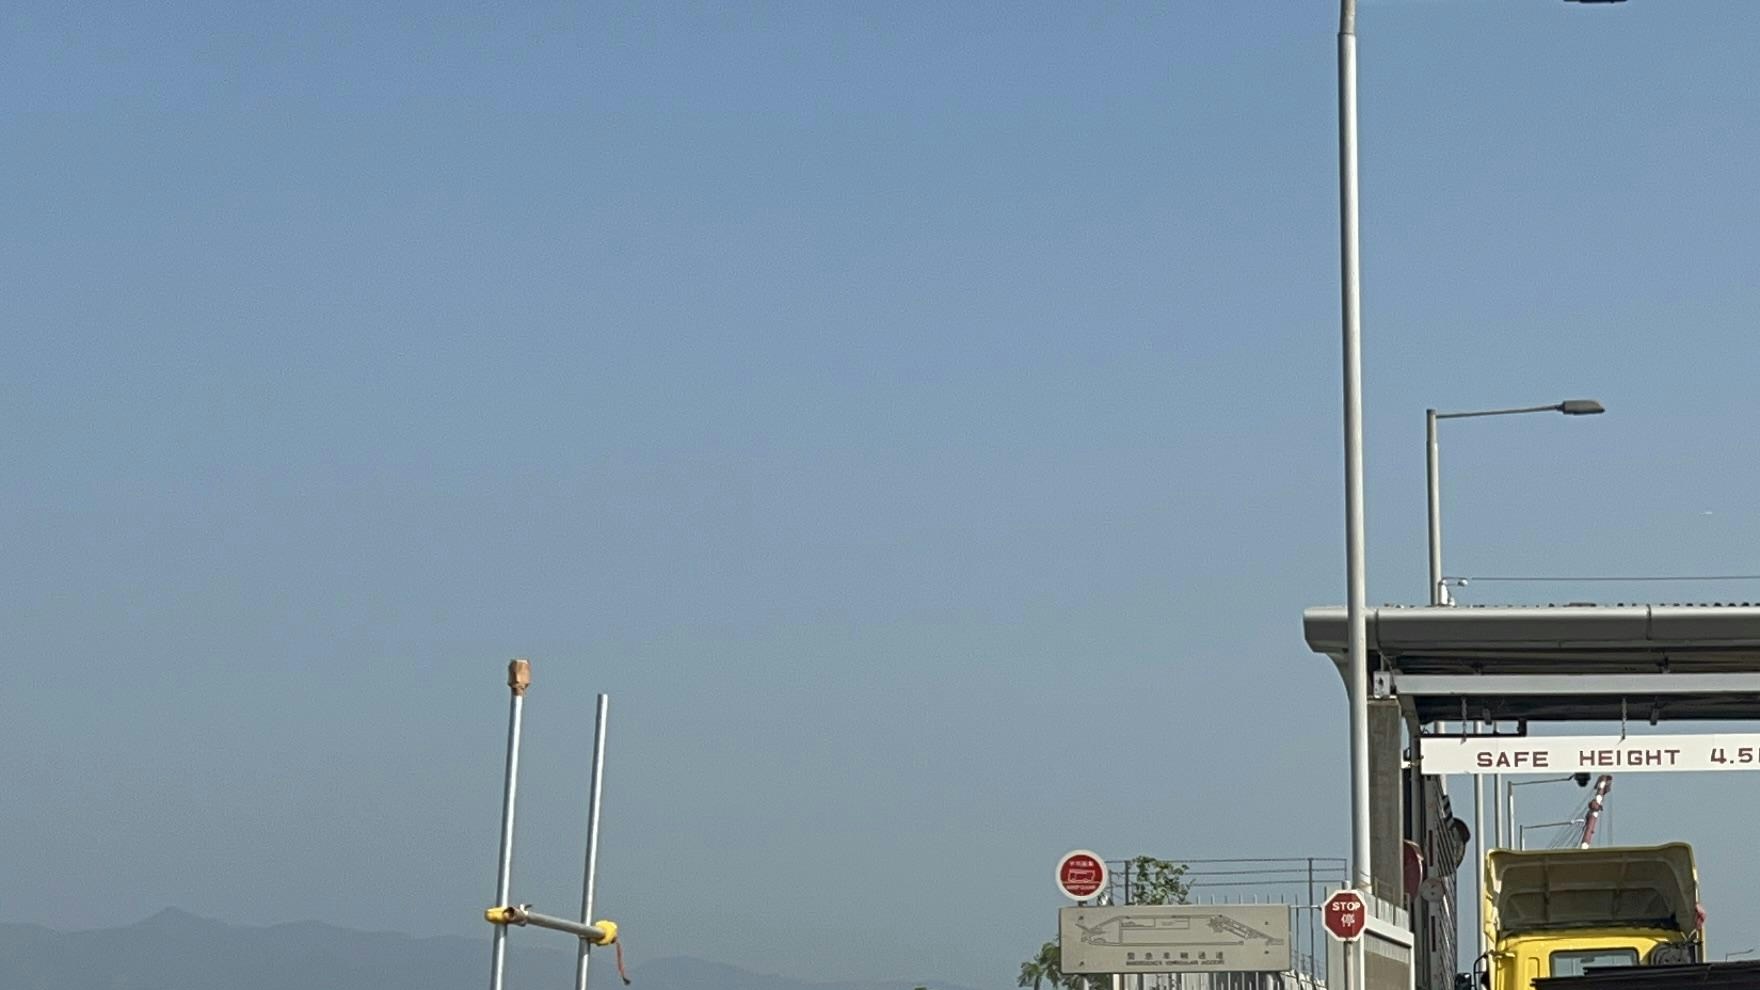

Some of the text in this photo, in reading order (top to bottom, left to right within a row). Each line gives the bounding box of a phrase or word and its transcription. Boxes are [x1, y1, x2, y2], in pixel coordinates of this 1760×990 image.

[1476, 751, 1549, 768] SAFE
[1579, 749, 1681, 766] HEIGHT
[1332, 901, 1360, 911] STOP
